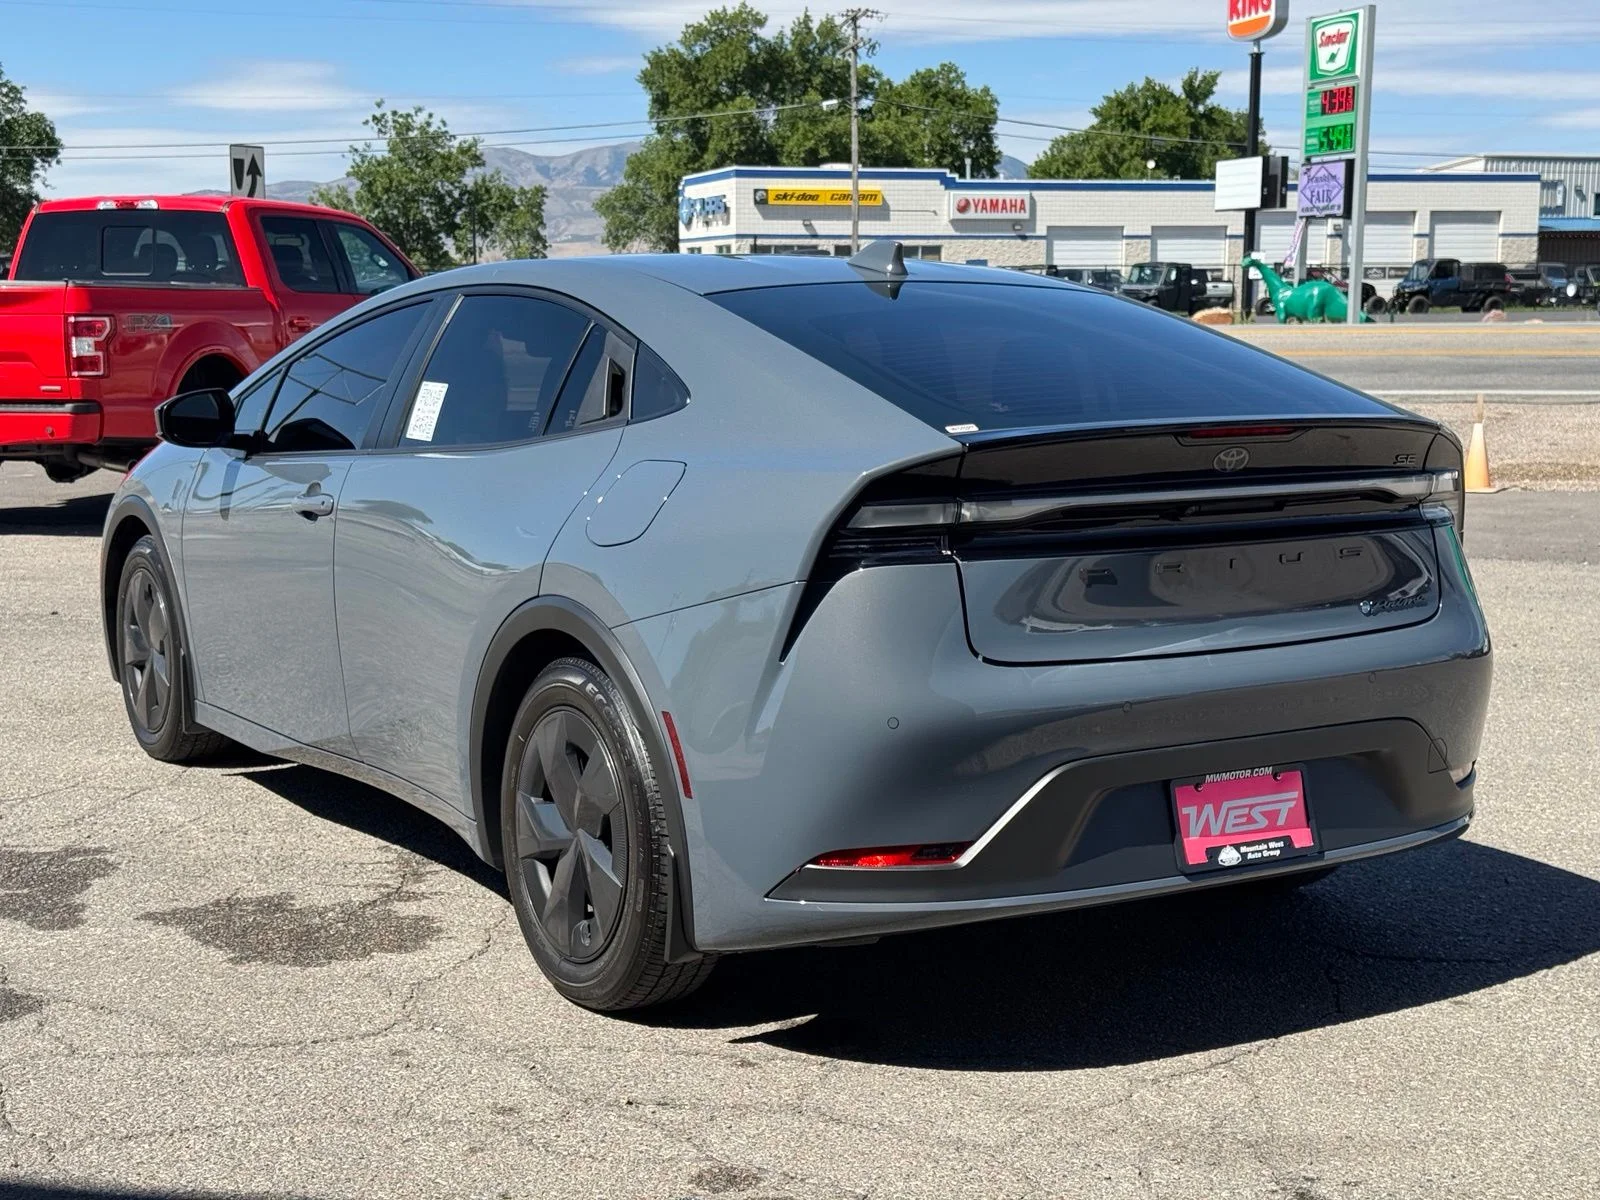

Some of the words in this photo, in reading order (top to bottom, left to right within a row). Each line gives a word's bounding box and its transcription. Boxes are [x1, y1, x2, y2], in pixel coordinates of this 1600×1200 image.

[1318, 28, 1350, 48] Sinclair
[972, 198, 1026, 214] YAMAHA
[127, 313, 173, 333] FX4
[1394, 454, 1416, 465] SE
[1205, 766, 1273, 784] MWMOTOR.COM
[1182, 791, 1299, 838] WEST
[1240, 843, 1267, 854] Mountain
[1268, 840, 1285, 849] West
[1247, 852, 1262, 860] Auto
[1262, 848, 1281, 857] Group
